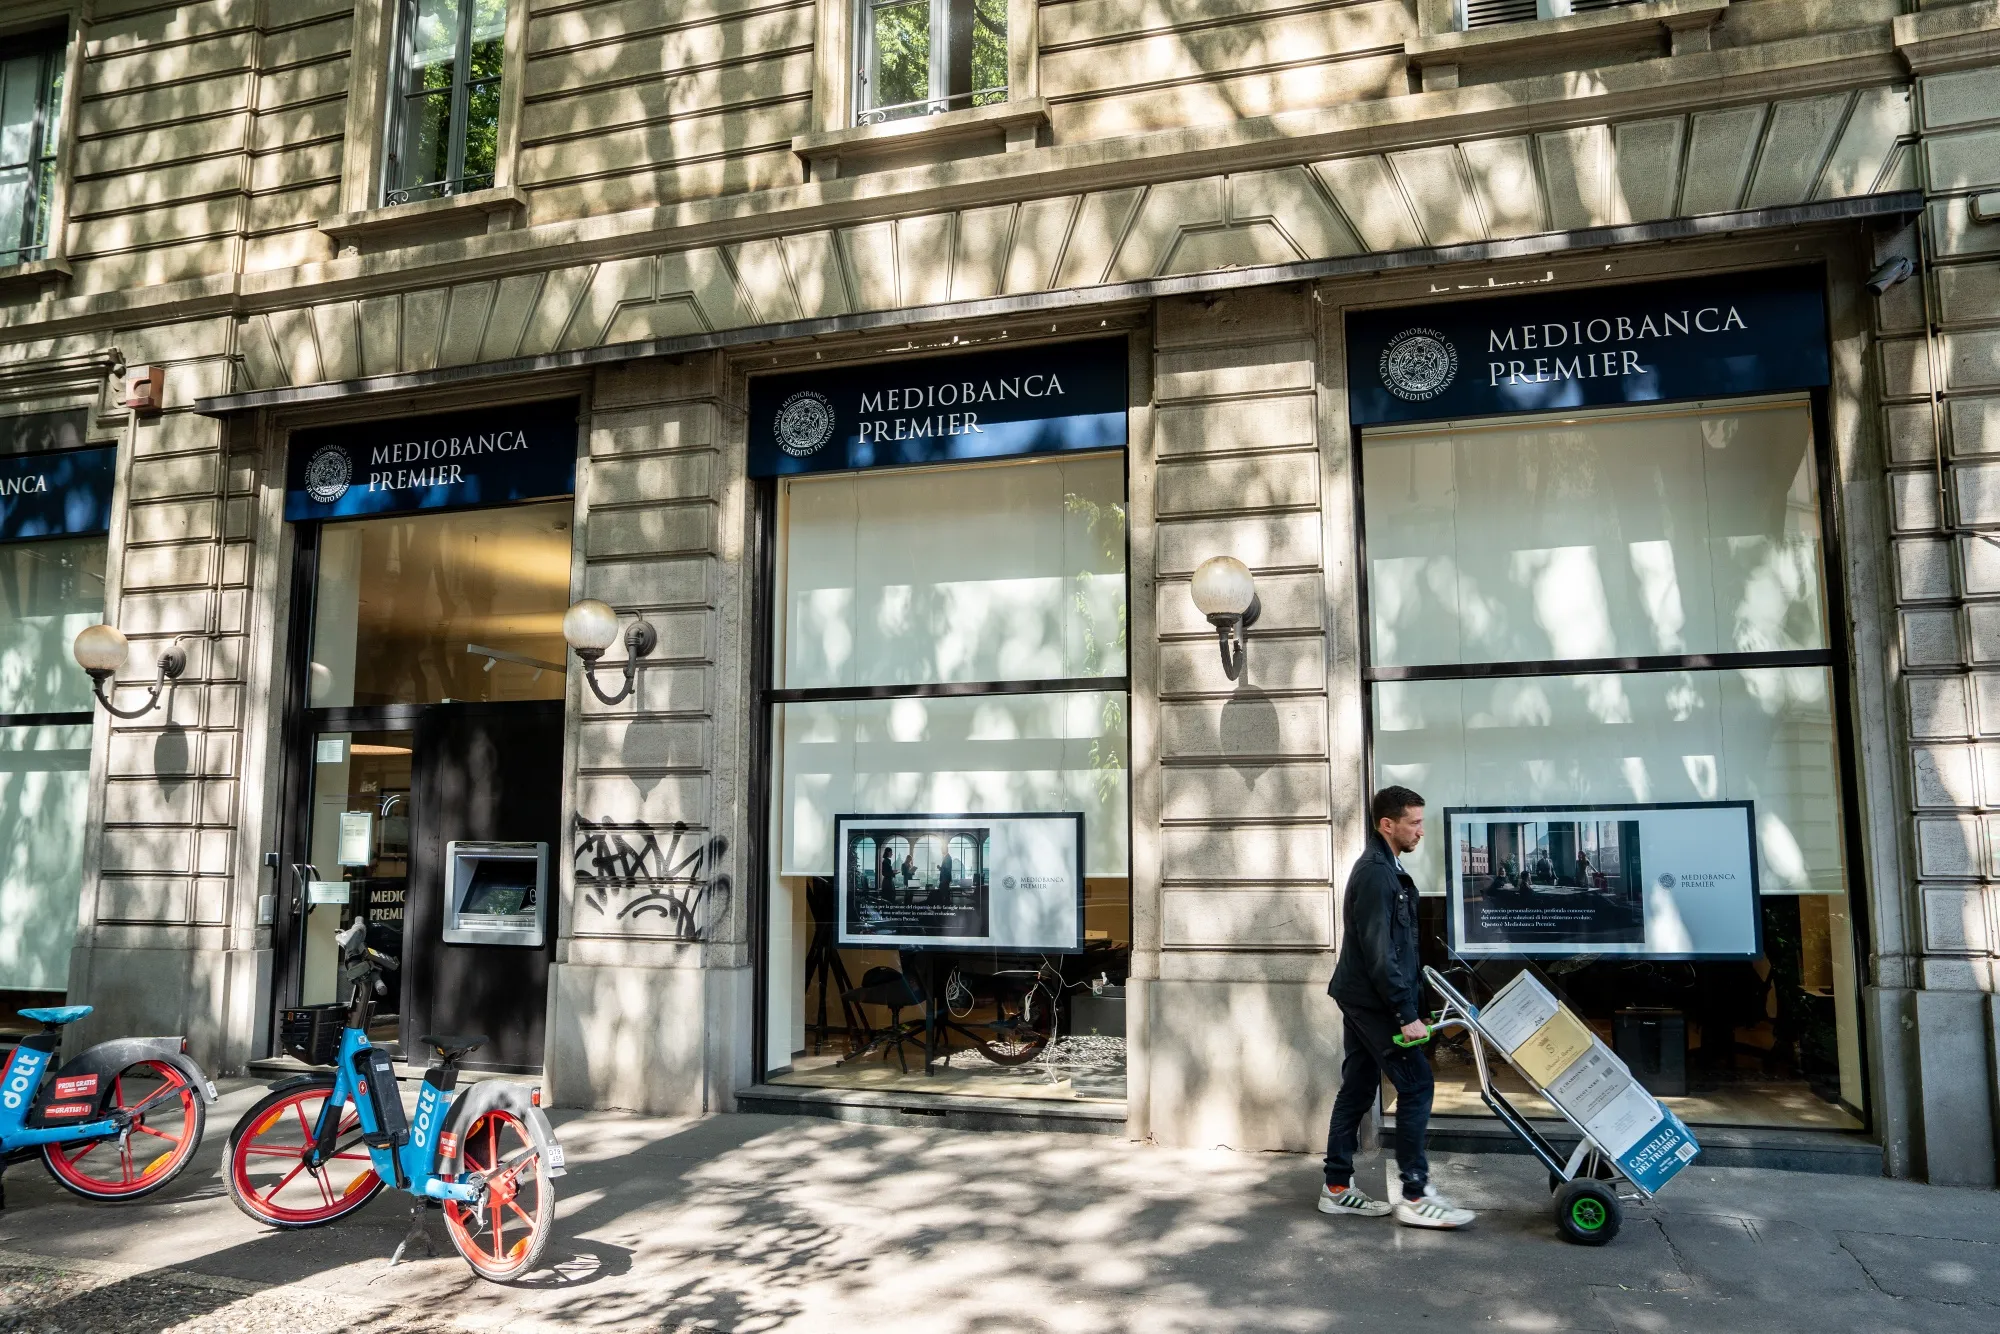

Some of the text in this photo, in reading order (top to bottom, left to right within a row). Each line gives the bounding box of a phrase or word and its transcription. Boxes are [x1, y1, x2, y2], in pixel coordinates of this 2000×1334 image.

[1388, 328, 1446, 348] MEDIOBANCA
[1488, 306, 1748, 353] MEDIOBANCA
[1380, 342, 1458, 400] BANCA DI CREDITO FINANZIARIO
[1489, 350, 1648, 387] PREMIER
[782, 390, 828, 408] MEDIOBANCA
[859, 373, 1065, 414] MEDIOBANCA
[774, 410, 783, 436] BANCA
[782, 444, 813, 456] CREDITO
[814, 404, 836, 451] FINANZIARIO
[858, 412, 984, 444] PREMIER
[371, 430, 528, 465] MEDIOBANCA
[368, 464, 465, 492] PREMIER
[310, 492, 334, 503] CREDITO
[370, 908, 404, 920] PREMI
[2, 1054, 40, 1109] dott
[414, 1088, 436, 1148] dott
[1629, 1128, 1674, 1169] CASTELLO
[1635, 1158, 1652, 1175] DEL
[1648, 1135, 1680, 1162] TREBBIO
